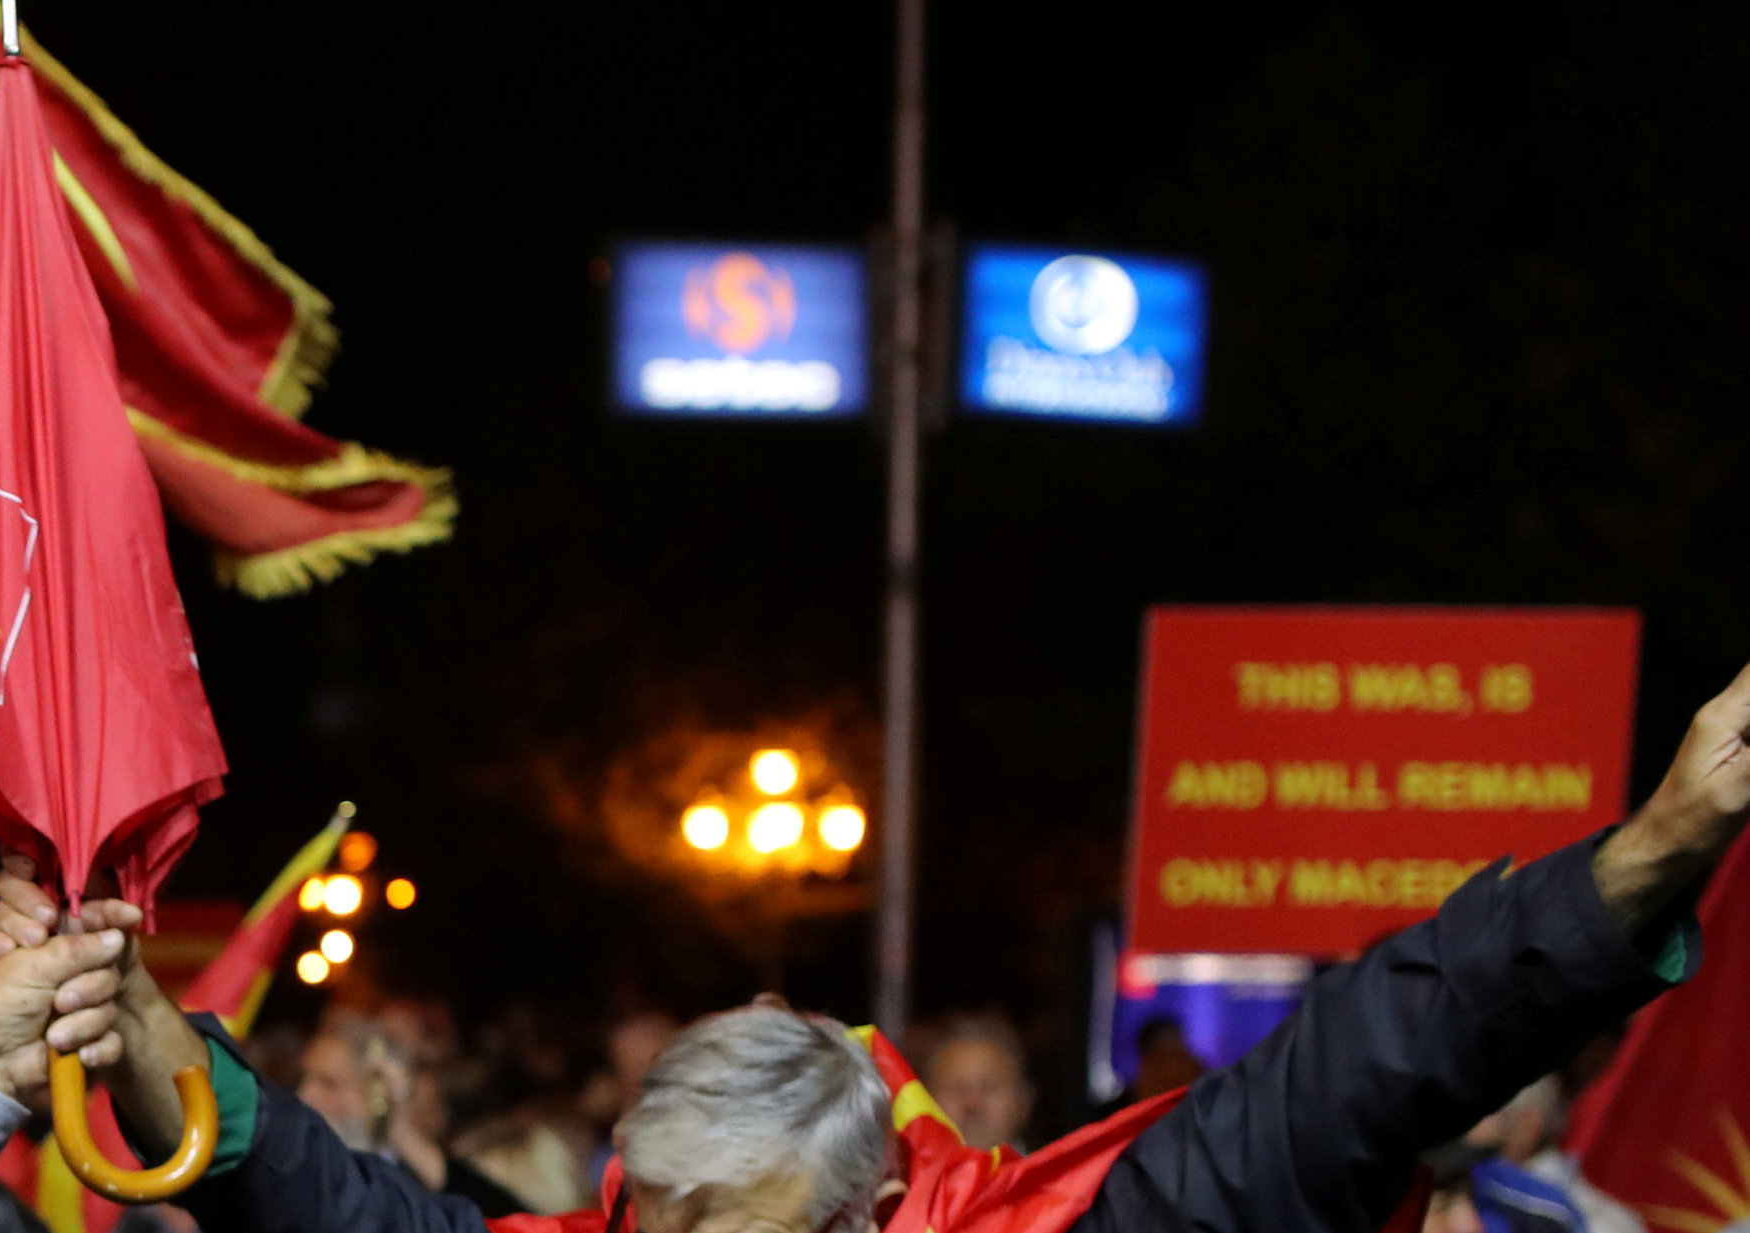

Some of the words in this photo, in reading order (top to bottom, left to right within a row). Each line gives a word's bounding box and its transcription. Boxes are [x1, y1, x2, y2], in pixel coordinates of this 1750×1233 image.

[1237, 662, 1341, 712] THIS
[1347, 662, 1473, 715] WAS,
[1480, 662, 1533, 713] IS
[1168, 761, 1269, 810] AND
[1273, 761, 1388, 811] WILL
[1396, 761, 1593, 811] REMAIN
[1160, 857, 1284, 907] ONLY
